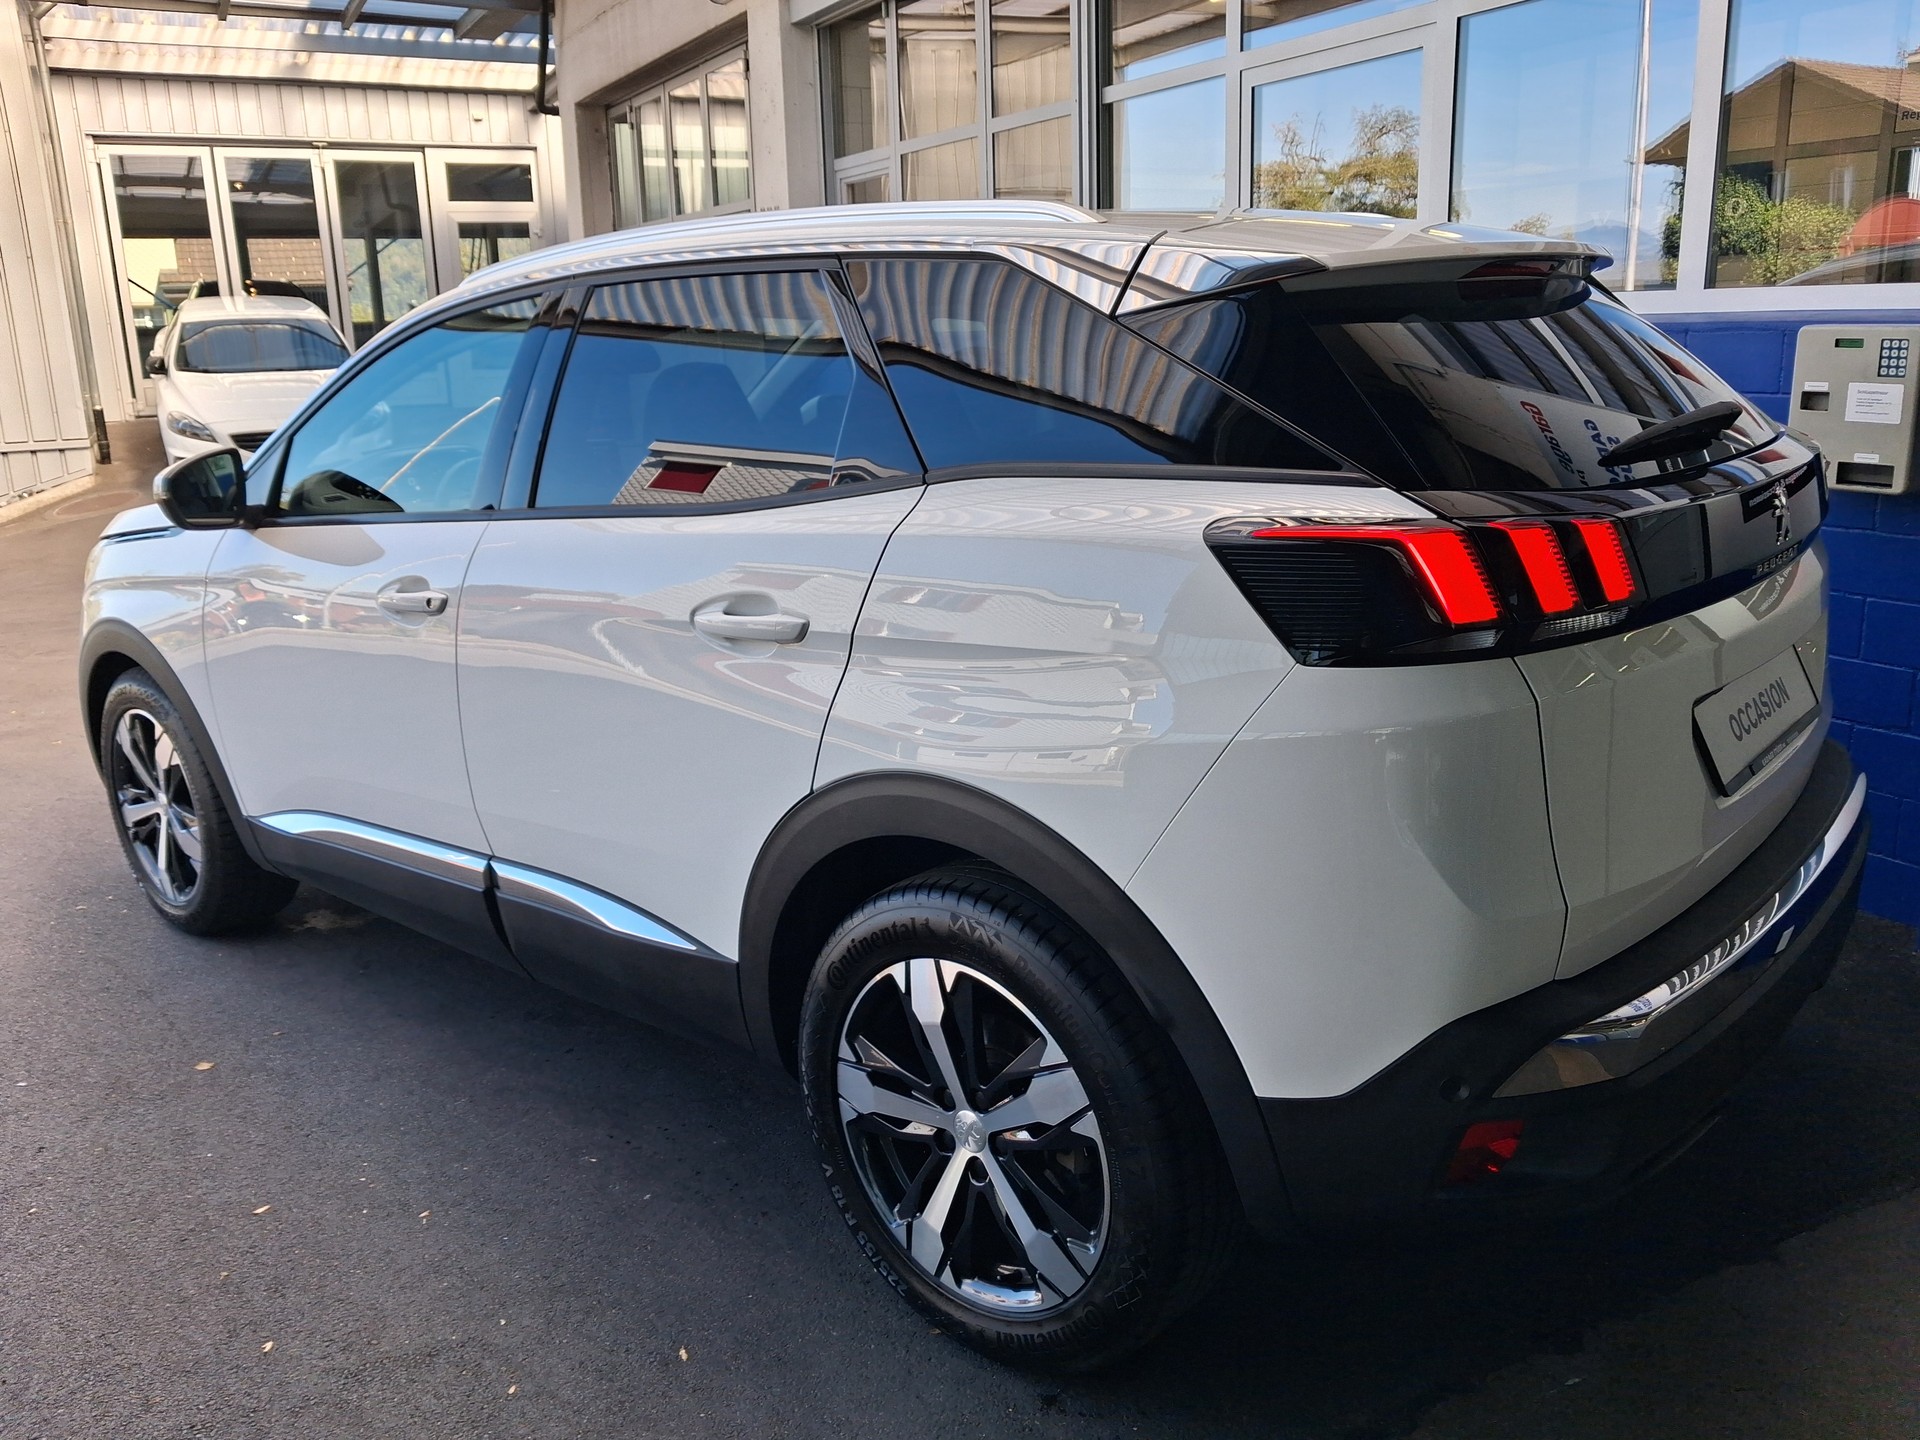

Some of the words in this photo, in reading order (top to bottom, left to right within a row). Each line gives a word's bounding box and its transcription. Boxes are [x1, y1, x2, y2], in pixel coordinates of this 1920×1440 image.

[1755, 543, 1799, 576] PEUGEOT
[1729, 676, 1790, 741] OCCASION
[826, 917, 917, 991] Continental
